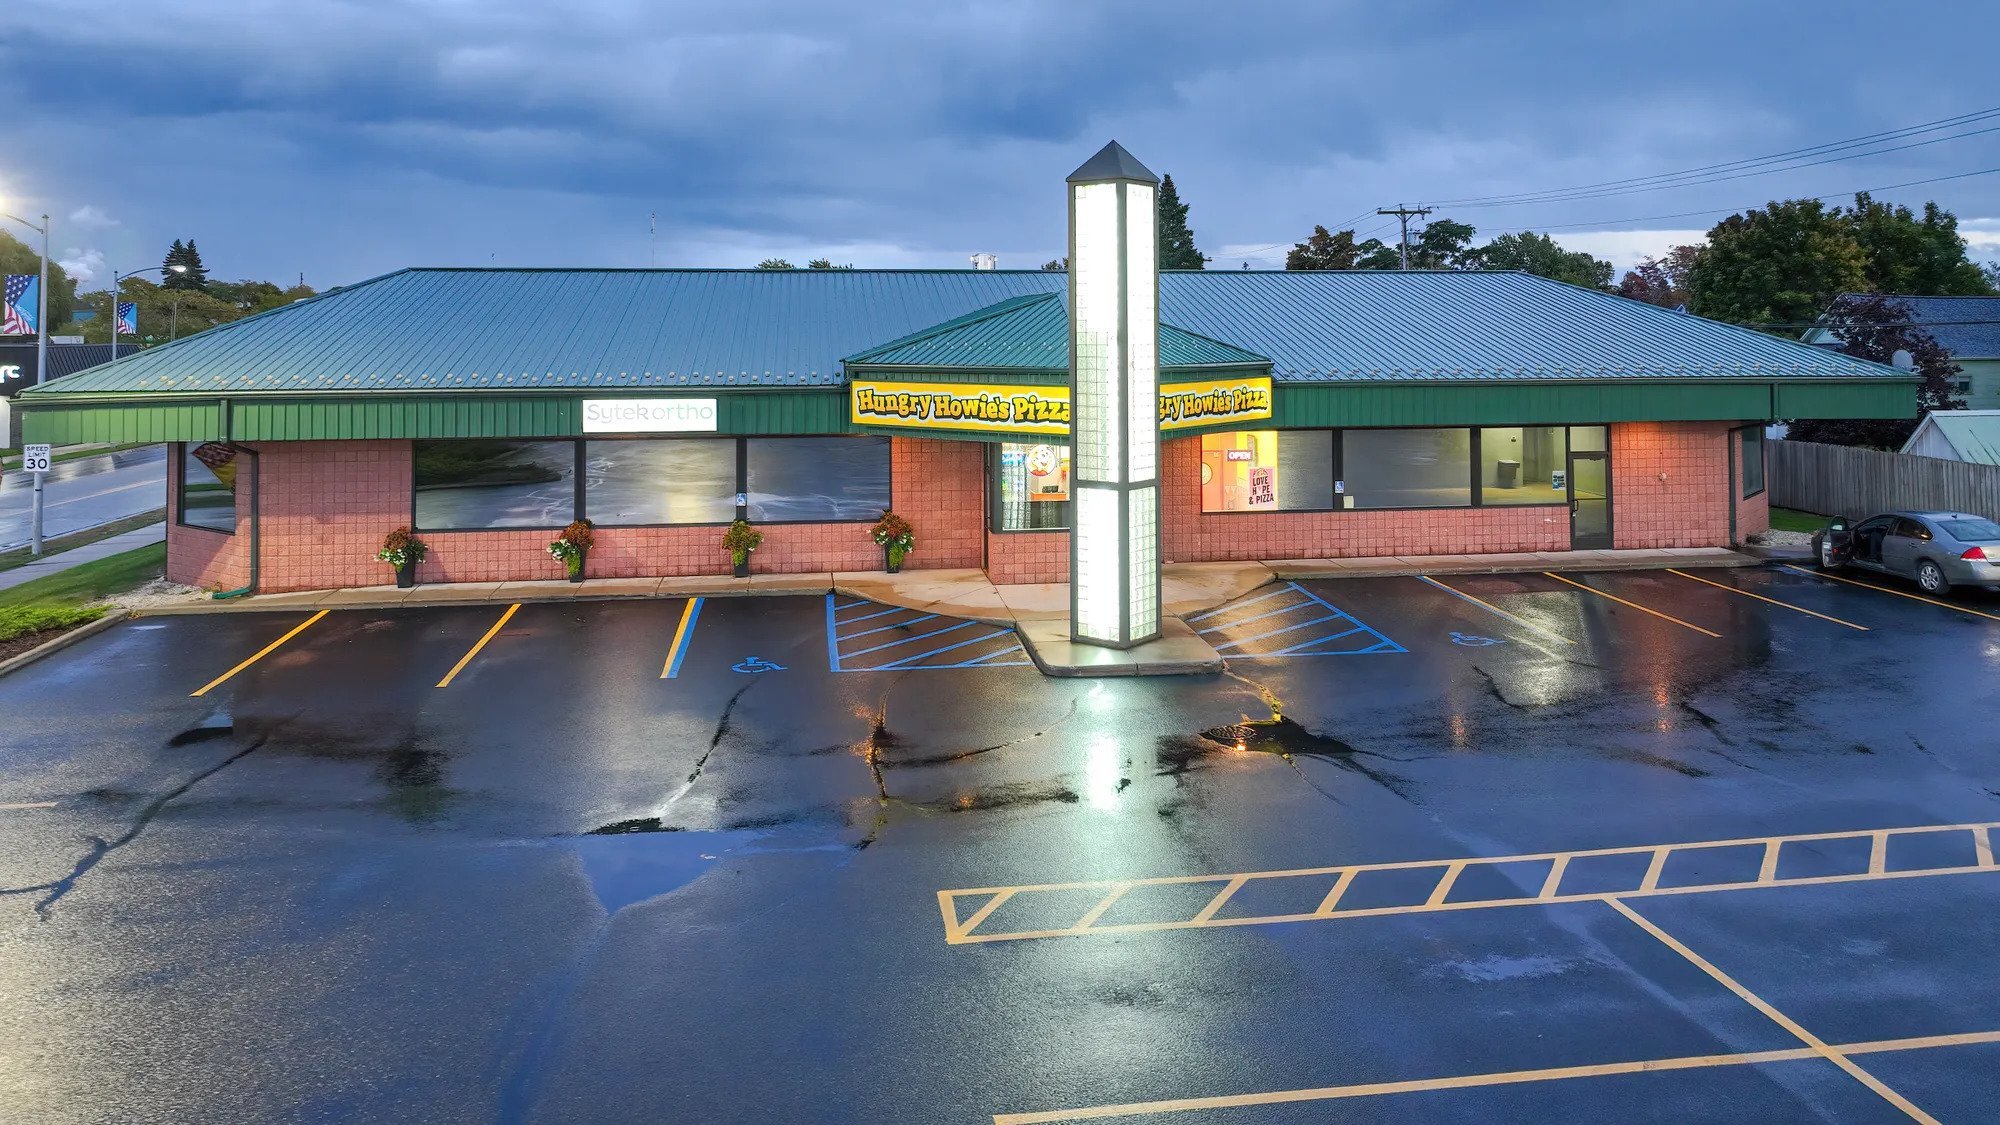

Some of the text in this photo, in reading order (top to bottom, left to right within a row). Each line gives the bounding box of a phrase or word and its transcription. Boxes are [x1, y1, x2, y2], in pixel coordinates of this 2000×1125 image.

[857, 388, 1070, 423] Hungry Howie's Pizza
[1183, 389, 1232, 418] Howie's
[1232, 387, 1268, 415] Pizza
[1228, 451, 1251, 460] OPEN
[26, 458, 48, 469] 30
[1252, 476, 1269, 486] LOVE
[1248, 493, 1274, 505] & PIZZA
